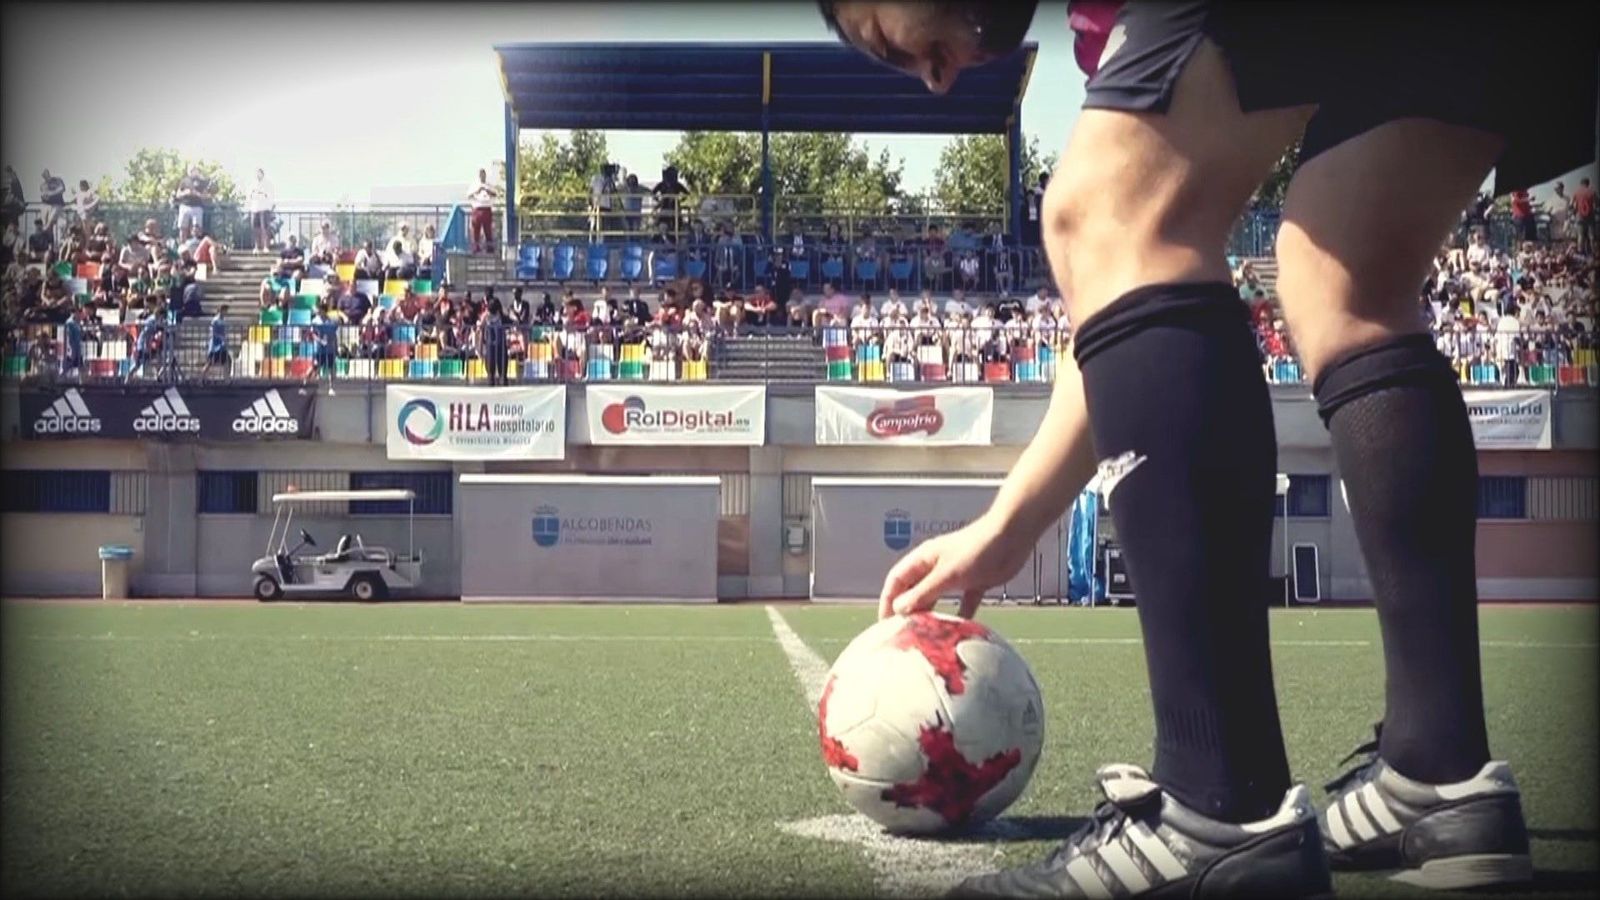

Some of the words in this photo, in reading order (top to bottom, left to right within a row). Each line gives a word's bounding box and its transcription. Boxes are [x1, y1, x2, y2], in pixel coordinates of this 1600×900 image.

[449, 403, 491, 431] HLA
[494, 403, 524, 417] Grupo
[1468, 402, 1543, 416] mmadrid
[34, 414, 102, 433] adidas
[133, 413, 200, 432] adidas
[232, 414, 299, 433] adidas
[494, 419, 555, 433] Hospitalario
[562, 517, 652, 532] ALCOBENDAS
